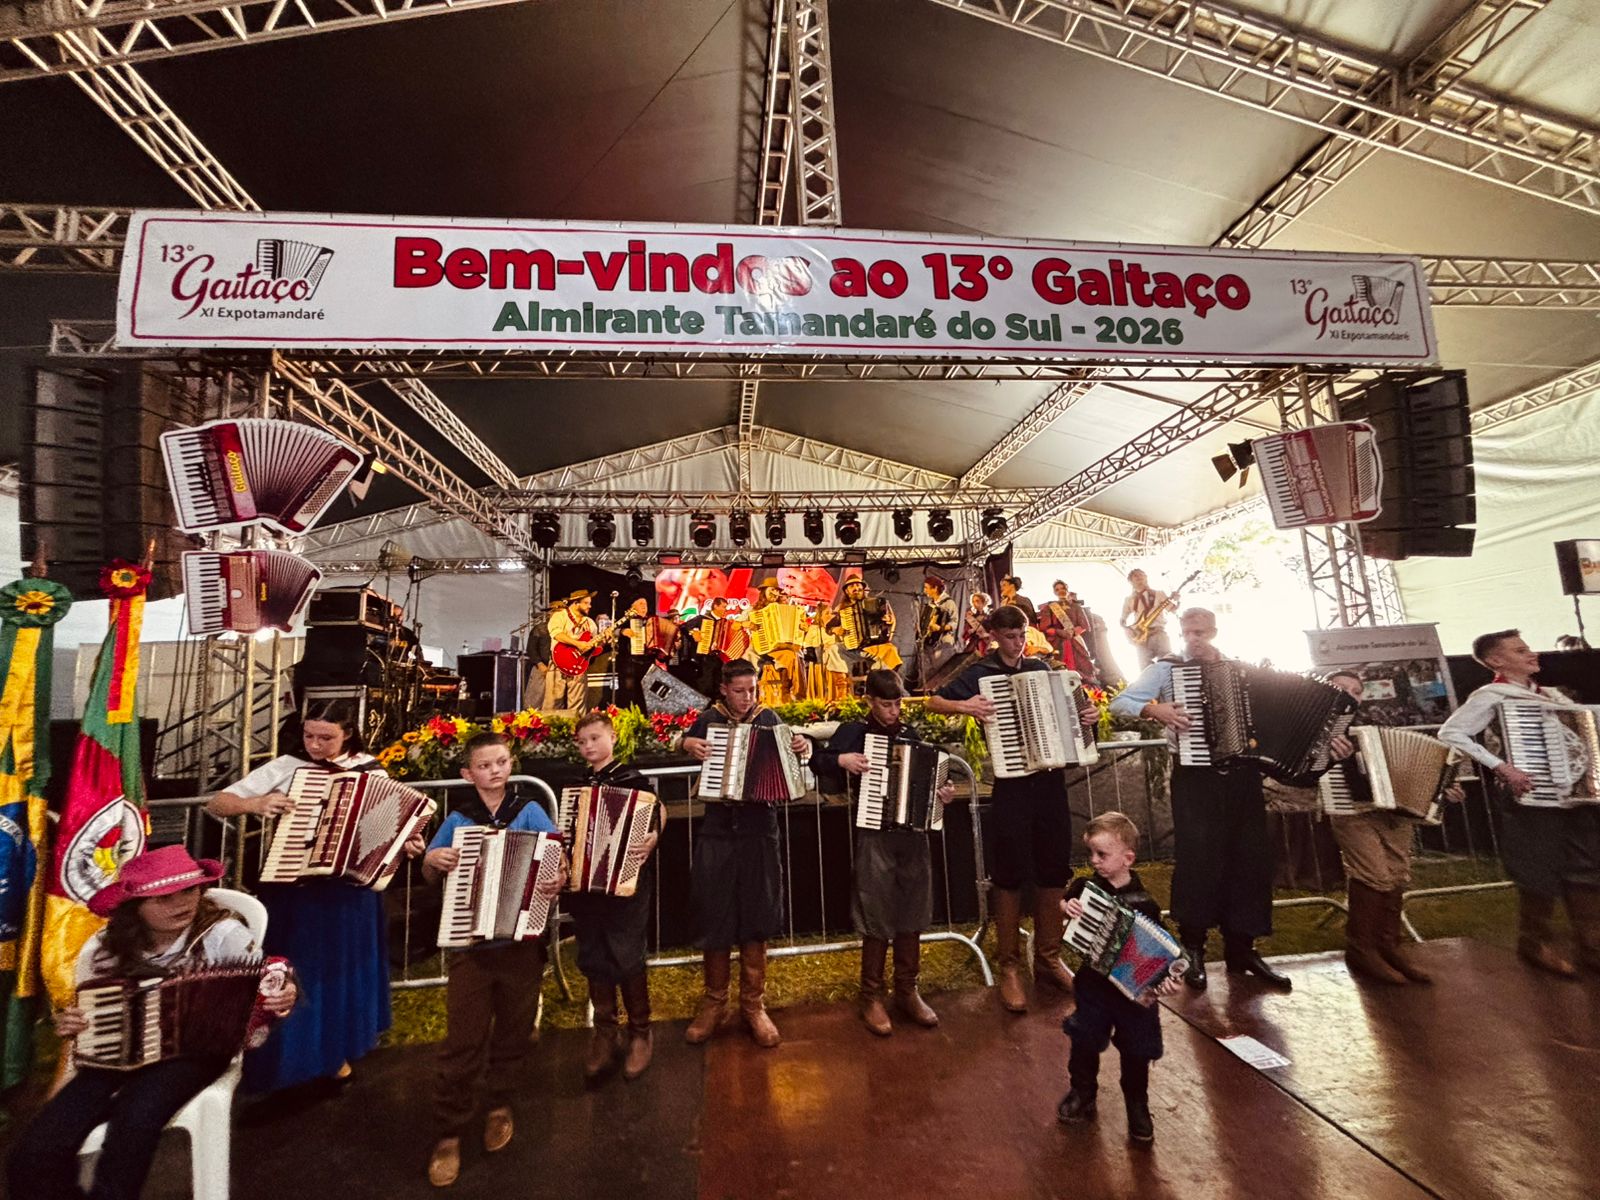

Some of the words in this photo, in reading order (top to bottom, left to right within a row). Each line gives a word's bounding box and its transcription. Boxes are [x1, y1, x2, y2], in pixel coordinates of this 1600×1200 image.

[171, 254, 312, 319] Gaitaço
[393, 236, 812, 297] Bem-vindos
[829, 257, 909, 299] ao
[1032, 258, 1251, 319] Gaitaço
[200, 307, 214, 317] XI
[217, 306, 325, 321] Expotamandaré
[492, 301, 705, 335] Almirante
[715, 305, 937, 341] Tamandaré
[947, 311, 996, 340] do
[1005, 312, 1062, 342] Sul
[1071, 324, 1086, 335] -
[1095, 316, 1184, 346] 2026
[1305, 287, 1395, 340] Gaitaço
